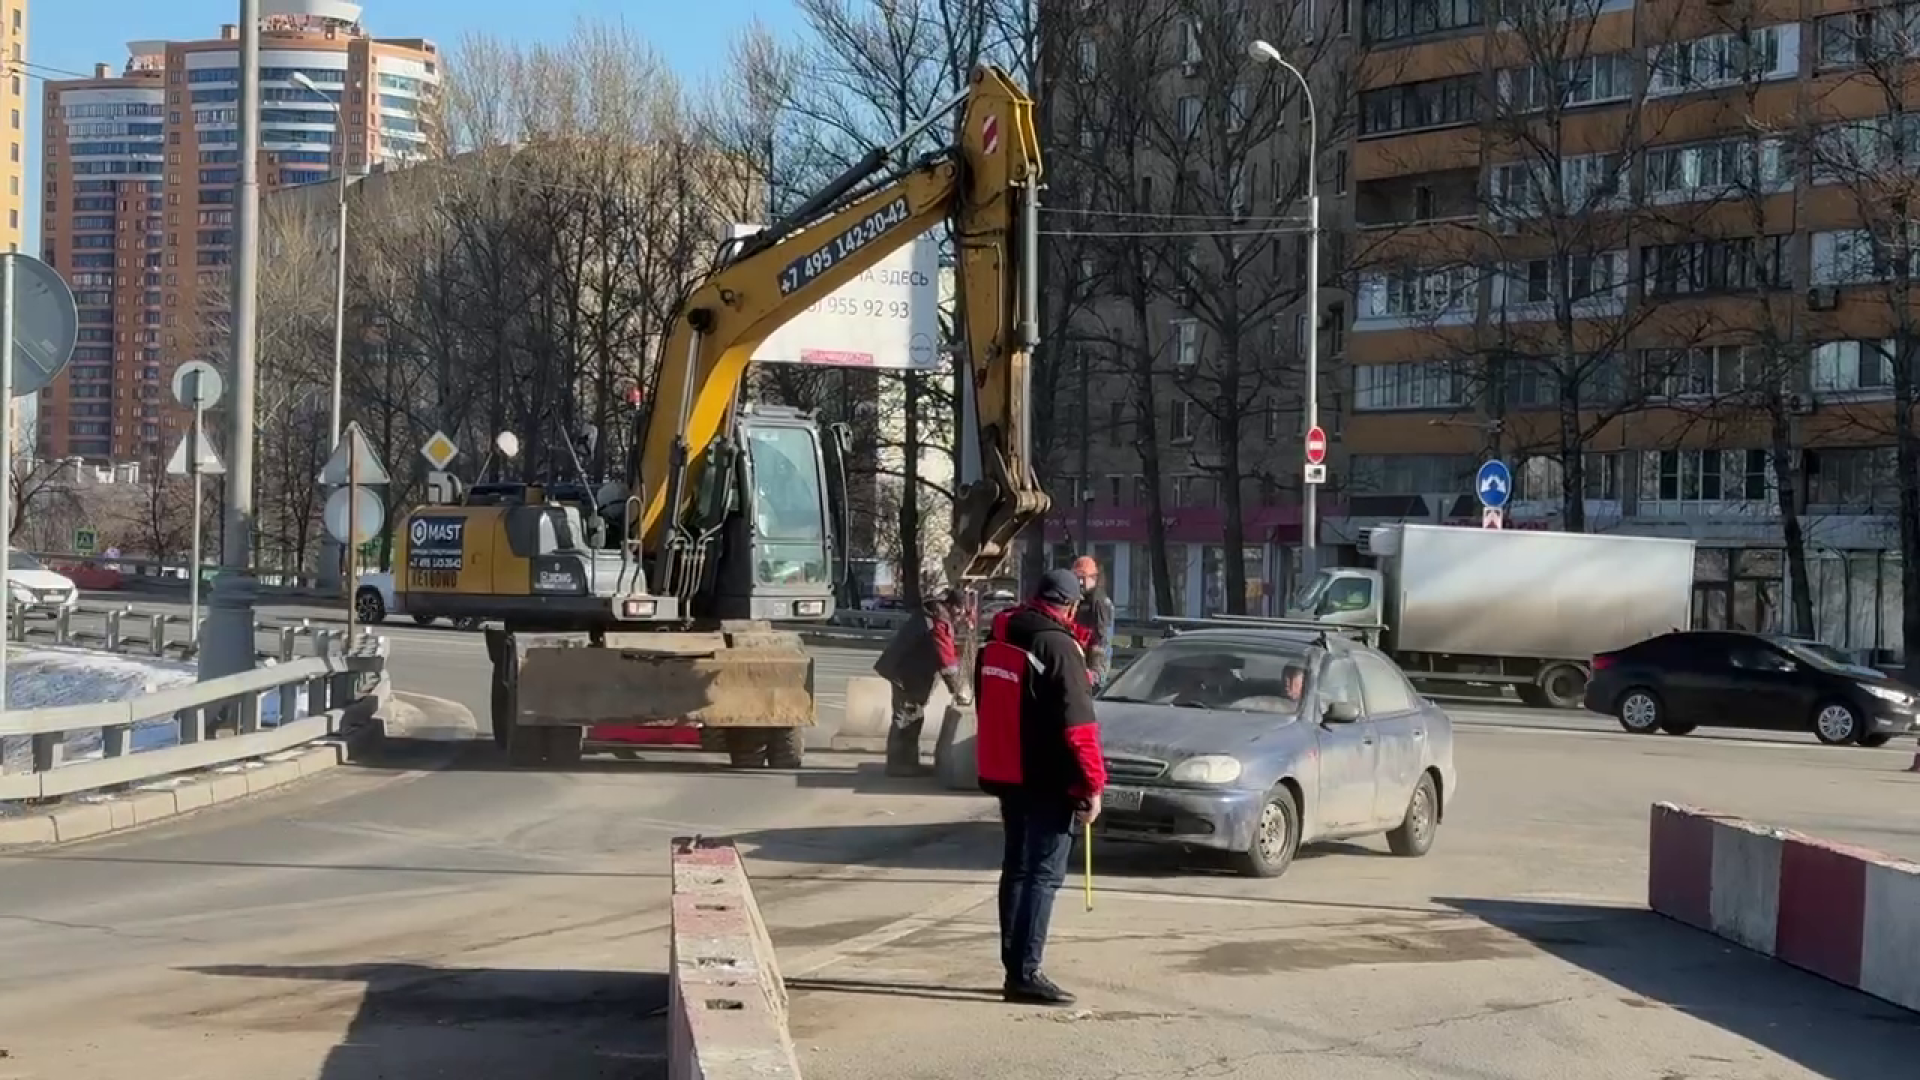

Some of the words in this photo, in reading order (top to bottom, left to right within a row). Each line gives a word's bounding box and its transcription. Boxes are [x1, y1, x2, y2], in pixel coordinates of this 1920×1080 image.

[781, 267, 798, 293] +7
[804, 247, 832, 278] 495
[836, 199, 908, 259] 142-20-42
[880, 269, 929, 286] ЗДЕСЬ
[827, 296, 858, 316] 955
[863, 299, 884, 317] 92
[888, 301, 910, 319] 93
[428, 524, 462, 541] MAST
